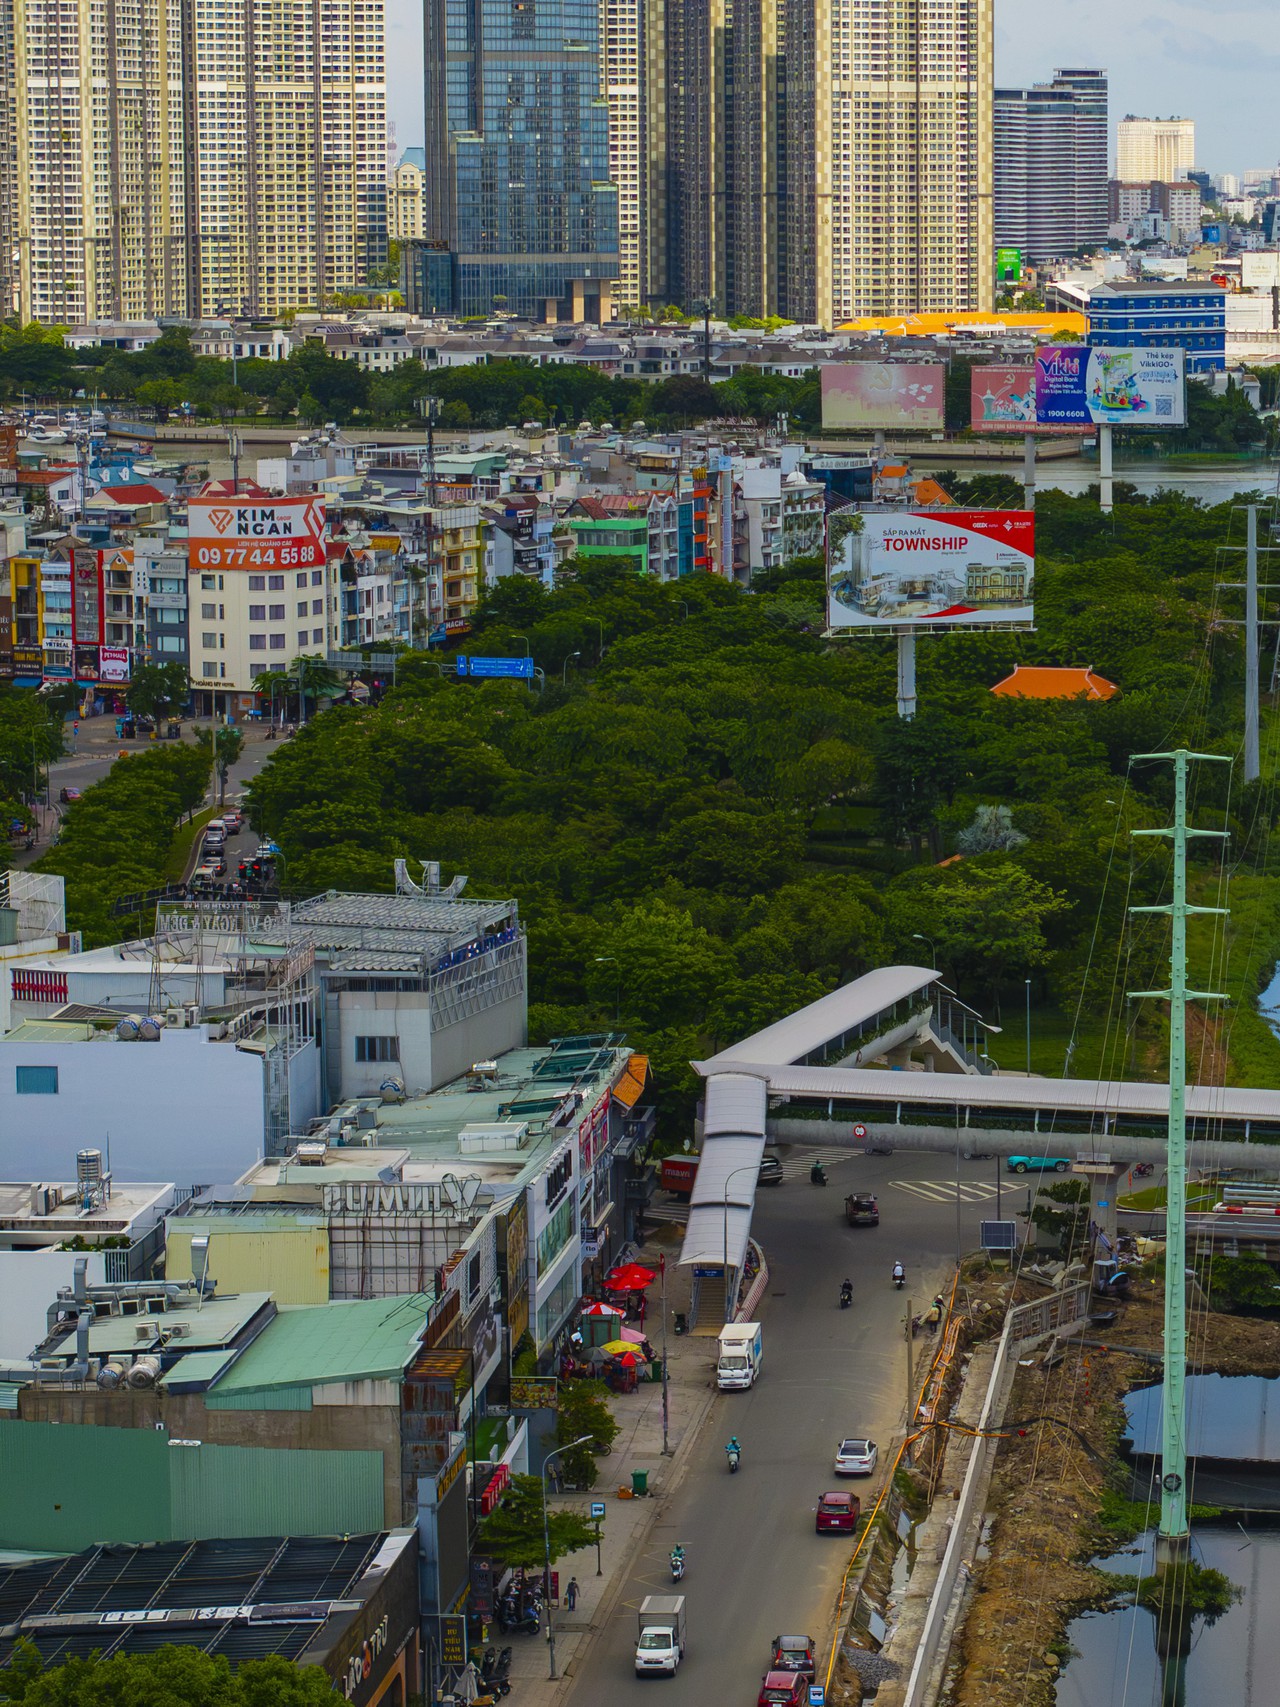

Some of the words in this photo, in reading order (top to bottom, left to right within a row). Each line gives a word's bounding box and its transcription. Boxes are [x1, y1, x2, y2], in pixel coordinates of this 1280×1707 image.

[1038, 350, 1080, 376] Vikki
[1047, 410, 1065, 418] 1900
[1066, 410, 1085, 418] 6608
[237, 509, 275, 521] KIM
[237, 522, 292, 535] NGAN
[882, 528, 897, 537] SẮP
[909, 527, 926, 536] MẮT
[883, 536, 968, 552] TOWNSHIP
[198, 547, 221, 564] 09
[224, 548, 247, 564] 77
[250, 549, 275, 564] 44
[280, 546, 299, 564] 55
[300, 545, 315, 562] 88
